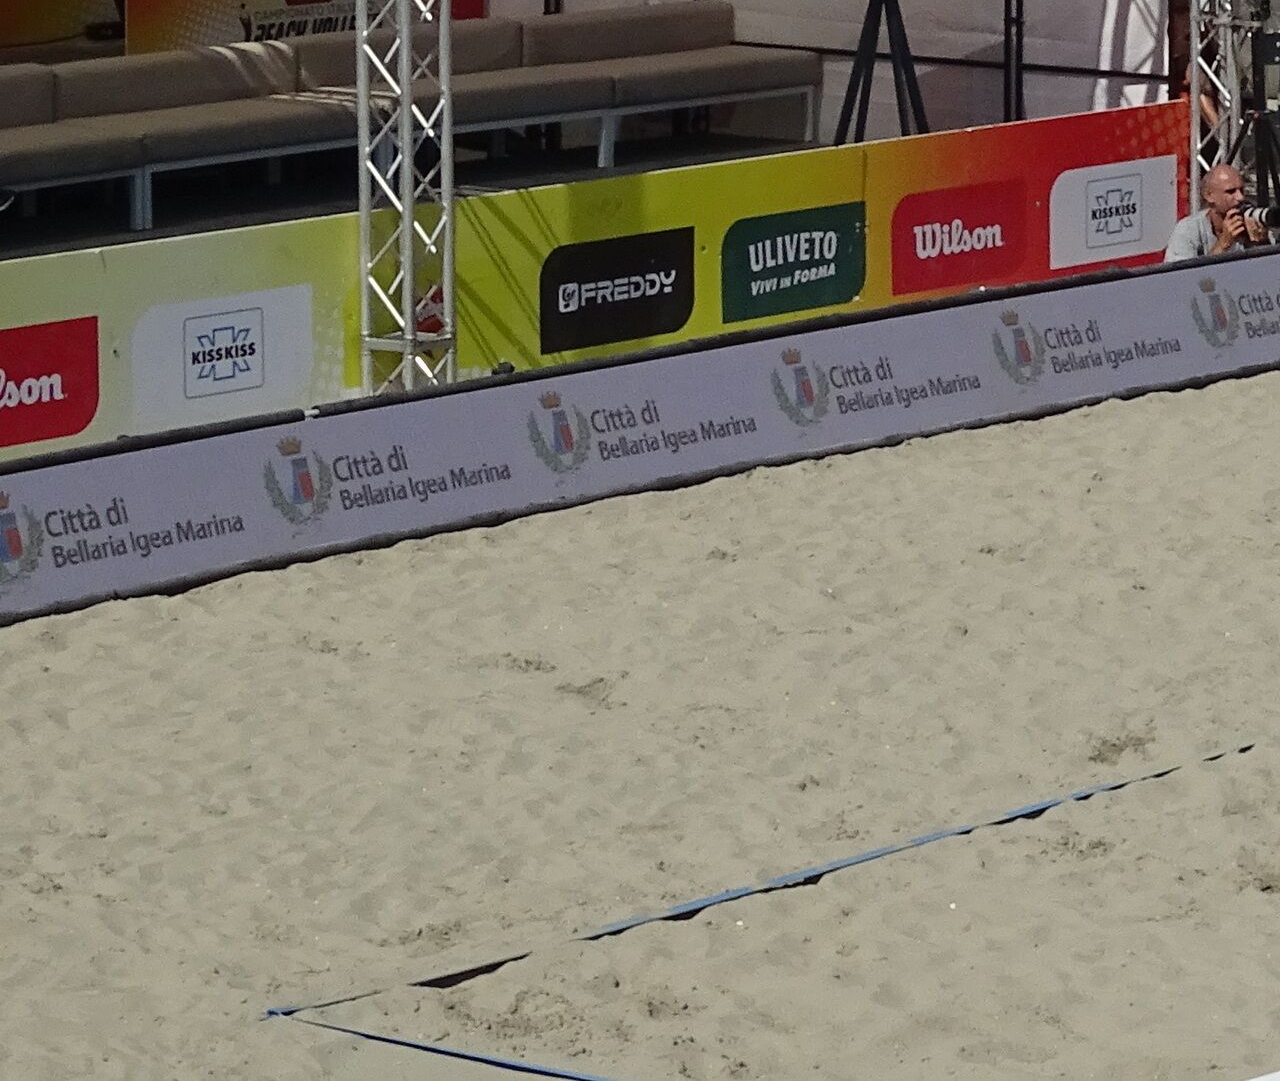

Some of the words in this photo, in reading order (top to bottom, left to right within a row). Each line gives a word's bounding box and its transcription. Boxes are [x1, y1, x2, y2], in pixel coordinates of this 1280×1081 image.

[1091, 202, 1137, 221] KISSKISS
[748, 230, 838, 273] ULIVETO
[913, 219, 1004, 260] Wilson
[580, 269, 677, 307] FREDDY
[751, 276, 778, 296] VIVI
[793, 262, 836, 286] FORMA
[1238, 290, 1274, 316] Città
[191, 341, 256, 366] KISSKISS
[1044, 323, 1084, 350] Città
[1085, 319, 1103, 344] di
[829, 360, 873, 390] Città
[875, 355, 894, 381] di
[1051, 349, 1103, 374] Bellaria
[1103, 347, 1134, 369] Igea
[1134, 337, 1182, 360] Marina
[836, 388, 895, 415] Bellaria
[895, 384, 929, 409] Igea
[929, 374, 981, 398] Marina
[590, 403, 638, 434] Città
[641, 399, 661, 425] di
[598, 433, 660, 462] Bellaria
[661, 428, 699, 454] Igea
[700, 415, 758, 442] Marina
[332, 450, 385, 483] Città
[387, 444, 409, 472] di
[339, 481, 408, 511] Bellaria
[408, 477, 449, 504] Igea
[450, 463, 512, 490] Marina
[44, 503, 101, 539] Città
[106, 496, 129, 528] di
[50, 534, 129, 569] Bellaria
[129, 529, 175, 558] Igea
[176, 514, 246, 544] Marina
